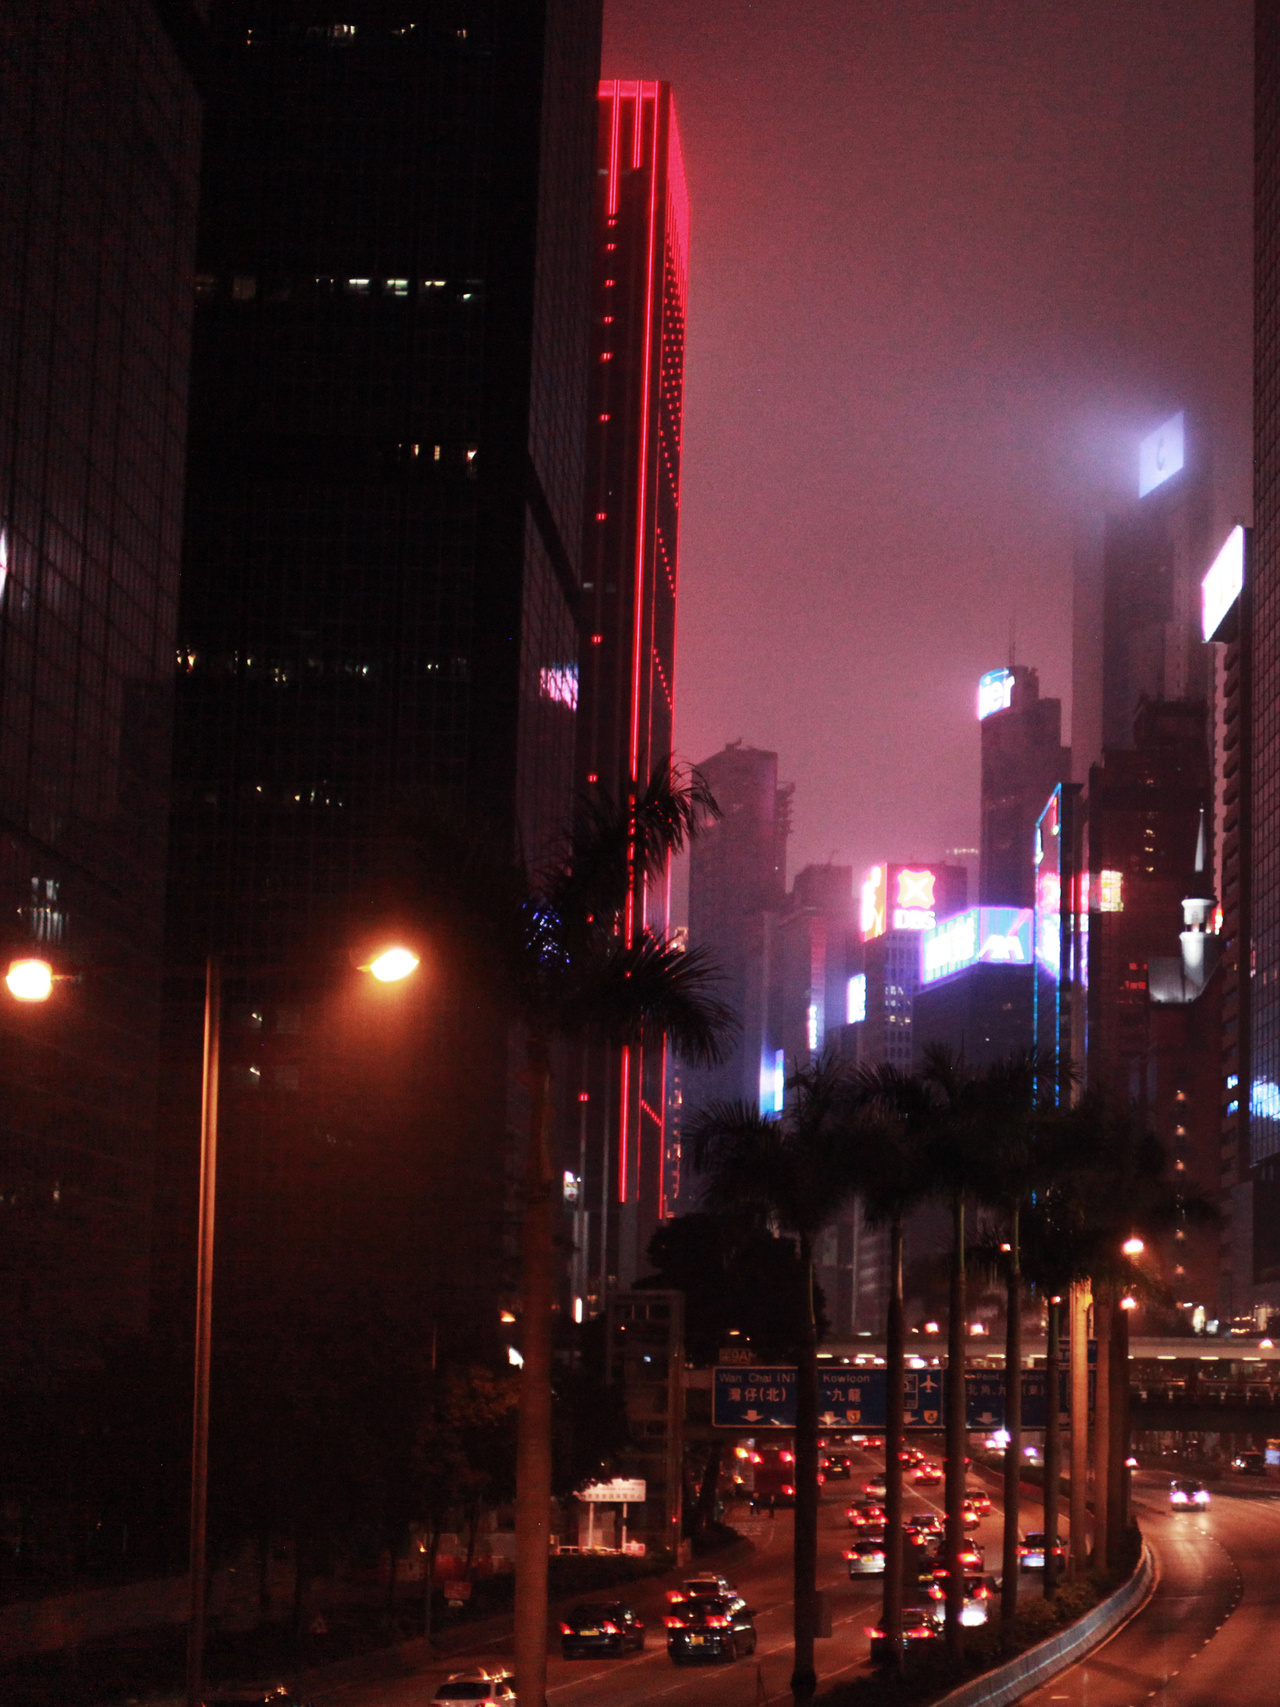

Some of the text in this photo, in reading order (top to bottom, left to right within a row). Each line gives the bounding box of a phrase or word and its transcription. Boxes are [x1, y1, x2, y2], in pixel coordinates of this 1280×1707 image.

[895, 908, 937, 930] DBS
[979, 933, 1025, 960] AXA
[719, 1372, 796, 1384] Wan Chai (N)
[823, 1372, 871, 1383] Kowloon
